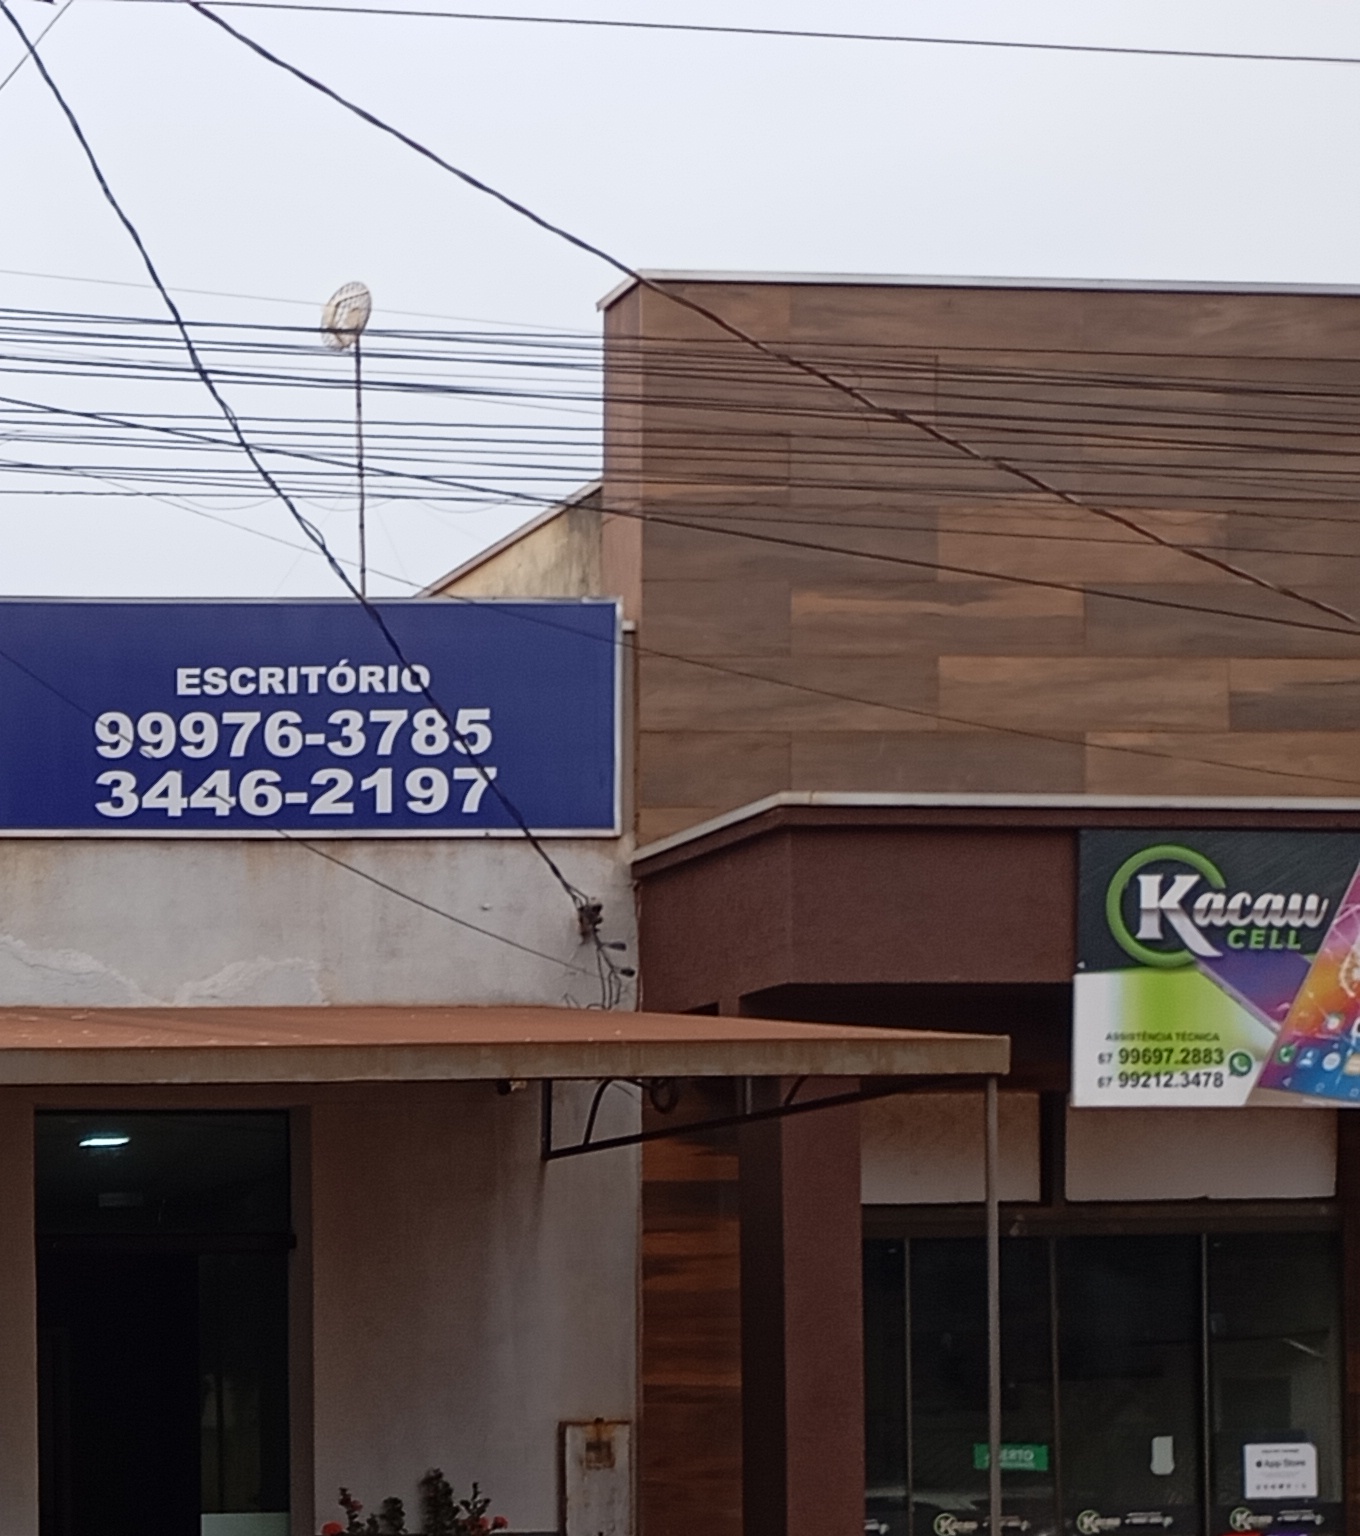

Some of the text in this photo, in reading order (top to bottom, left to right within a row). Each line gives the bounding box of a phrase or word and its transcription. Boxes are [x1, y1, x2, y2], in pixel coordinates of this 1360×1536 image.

[176, 658, 431, 696] ESCRITÓRIO
[94, 707, 493, 760] 99976-3785
[94, 766, 498, 818] 3446-2197
[1136, 873, 1330, 957] Kacau
[1227, 929, 1302, 949] CELL
[1118, 1048, 1224, 1066] 99697.2883
[1118, 1071, 1224, 1088] 99212.3478
